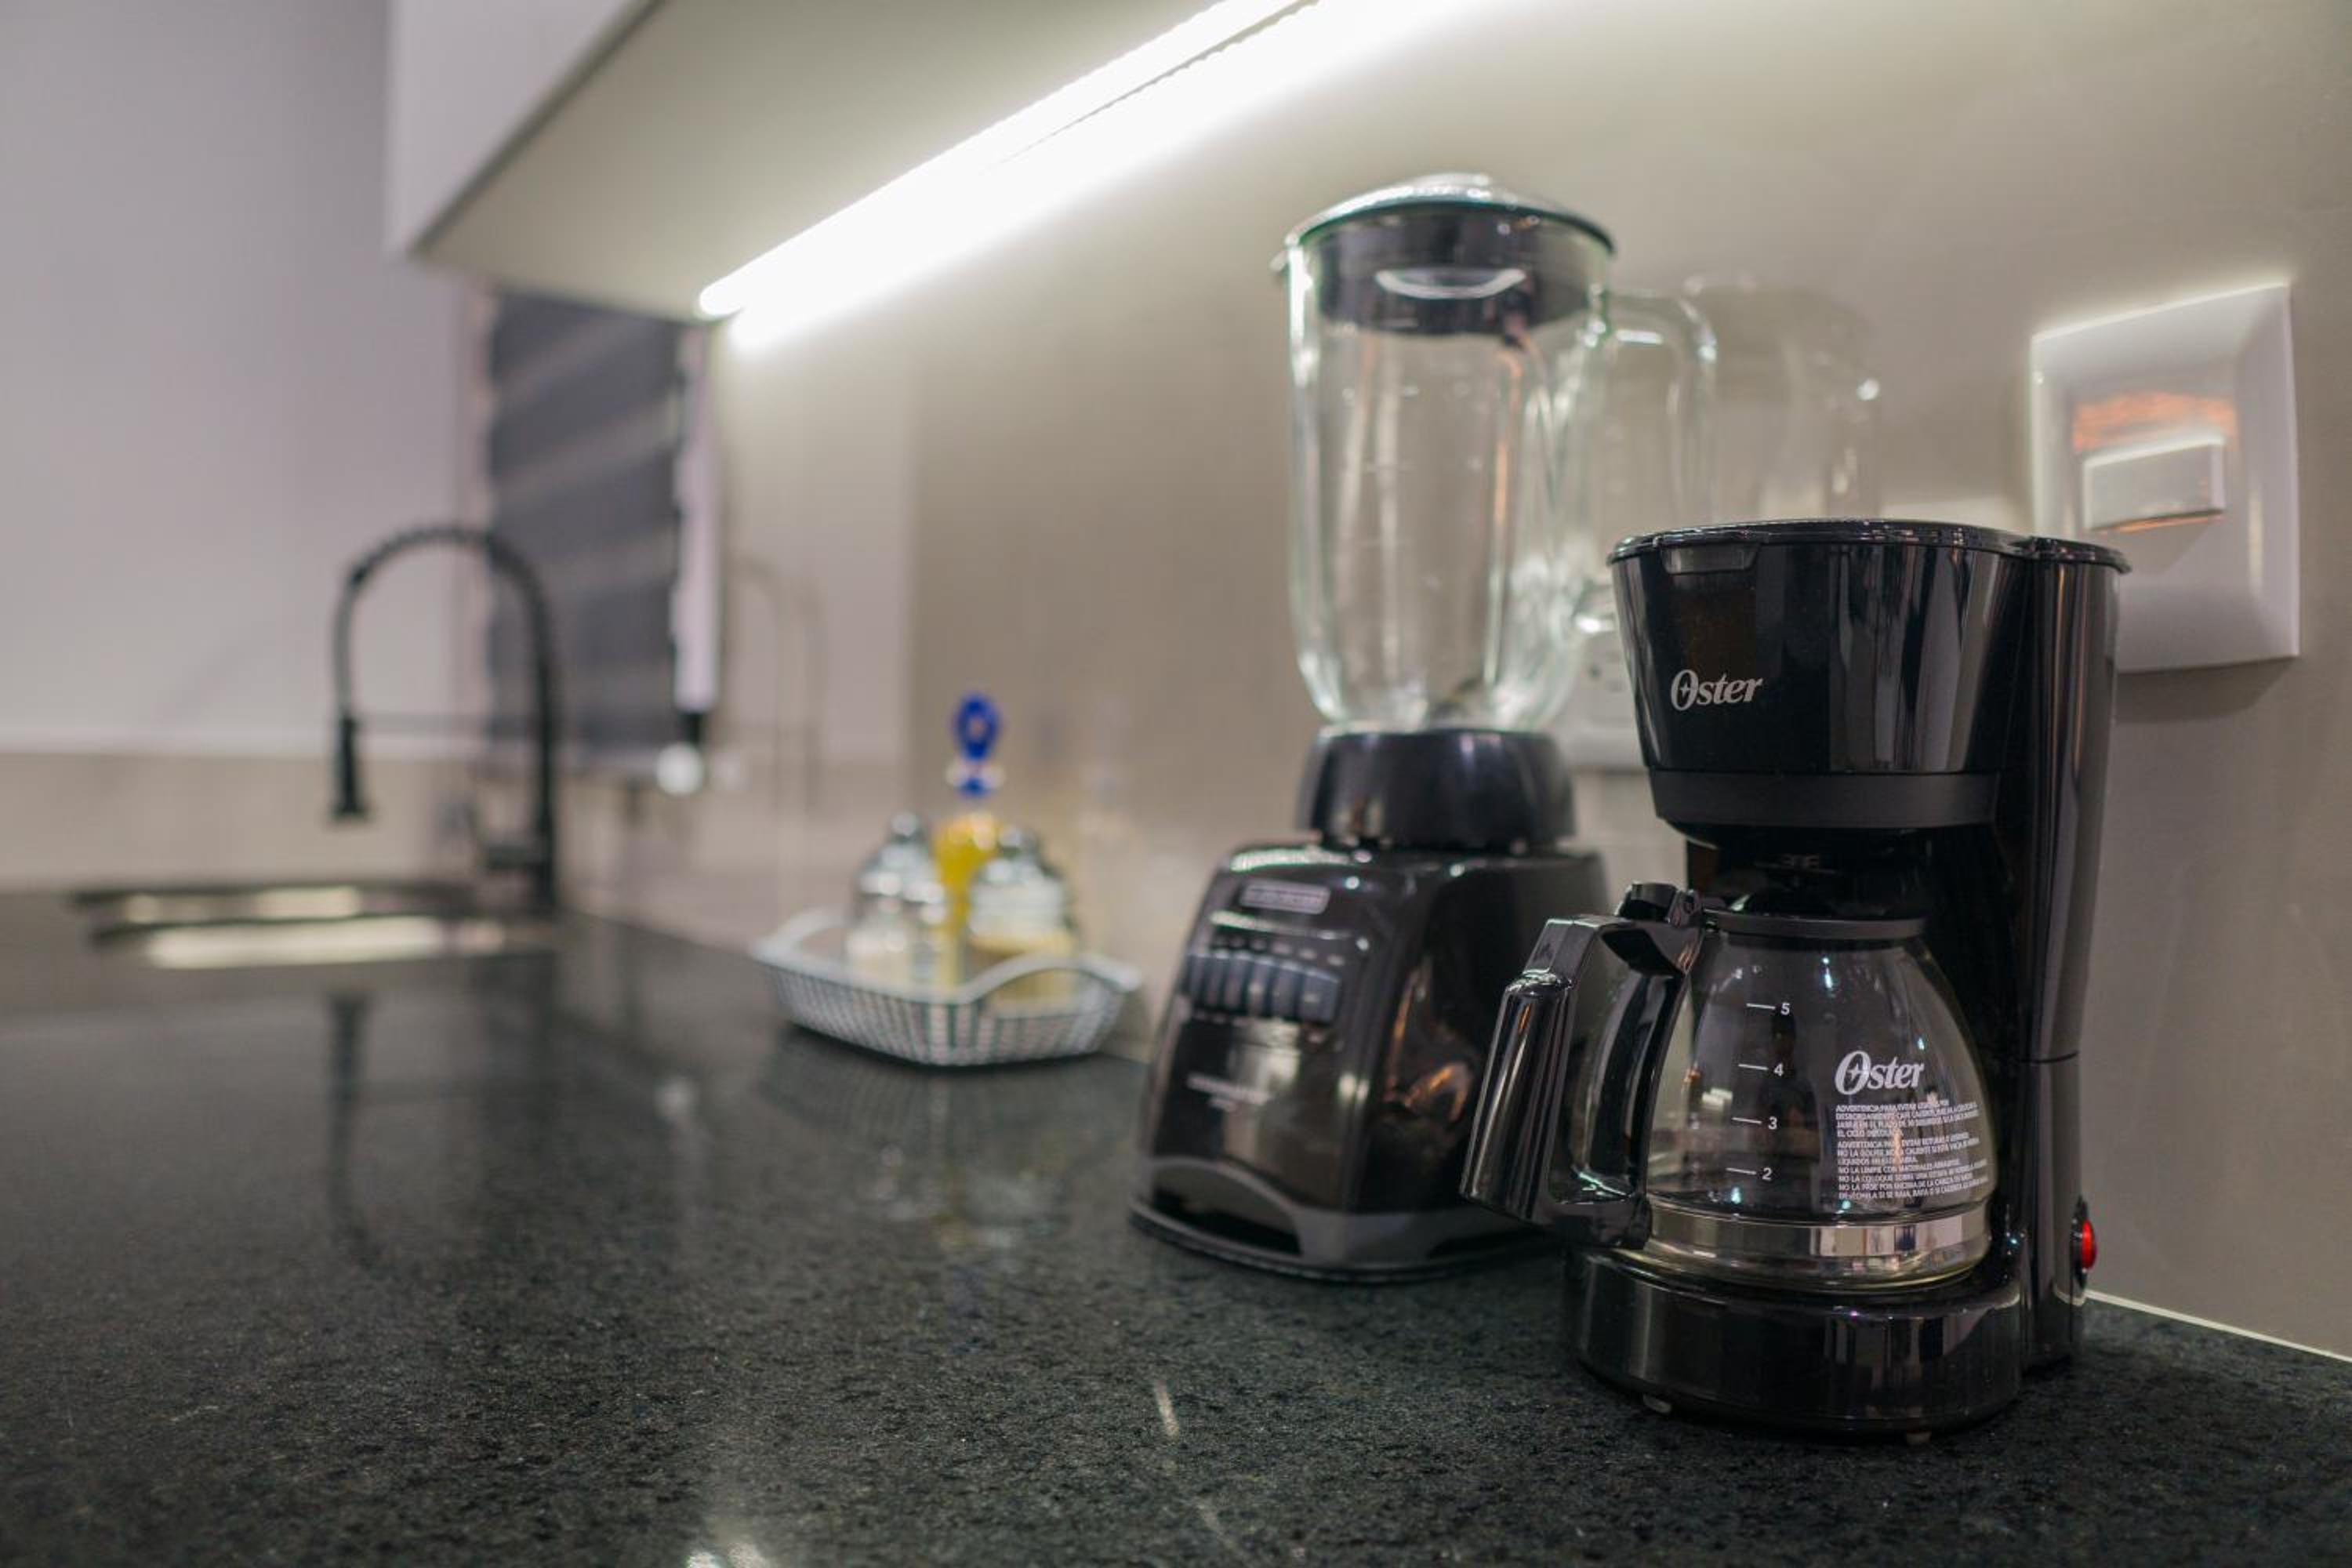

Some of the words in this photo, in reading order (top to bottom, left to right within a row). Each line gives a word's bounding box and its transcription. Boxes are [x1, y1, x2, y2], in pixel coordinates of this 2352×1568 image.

[1671, 669, 1763, 711] Oster
[1780, 1002, 1790, 1015] 5
[1773, 1063, 1784, 1077] 4
[1835, 1051, 1925, 1095] Oster
[1768, 1116, 1777, 1130] 3
[1762, 1167, 1773, 1181] 2
